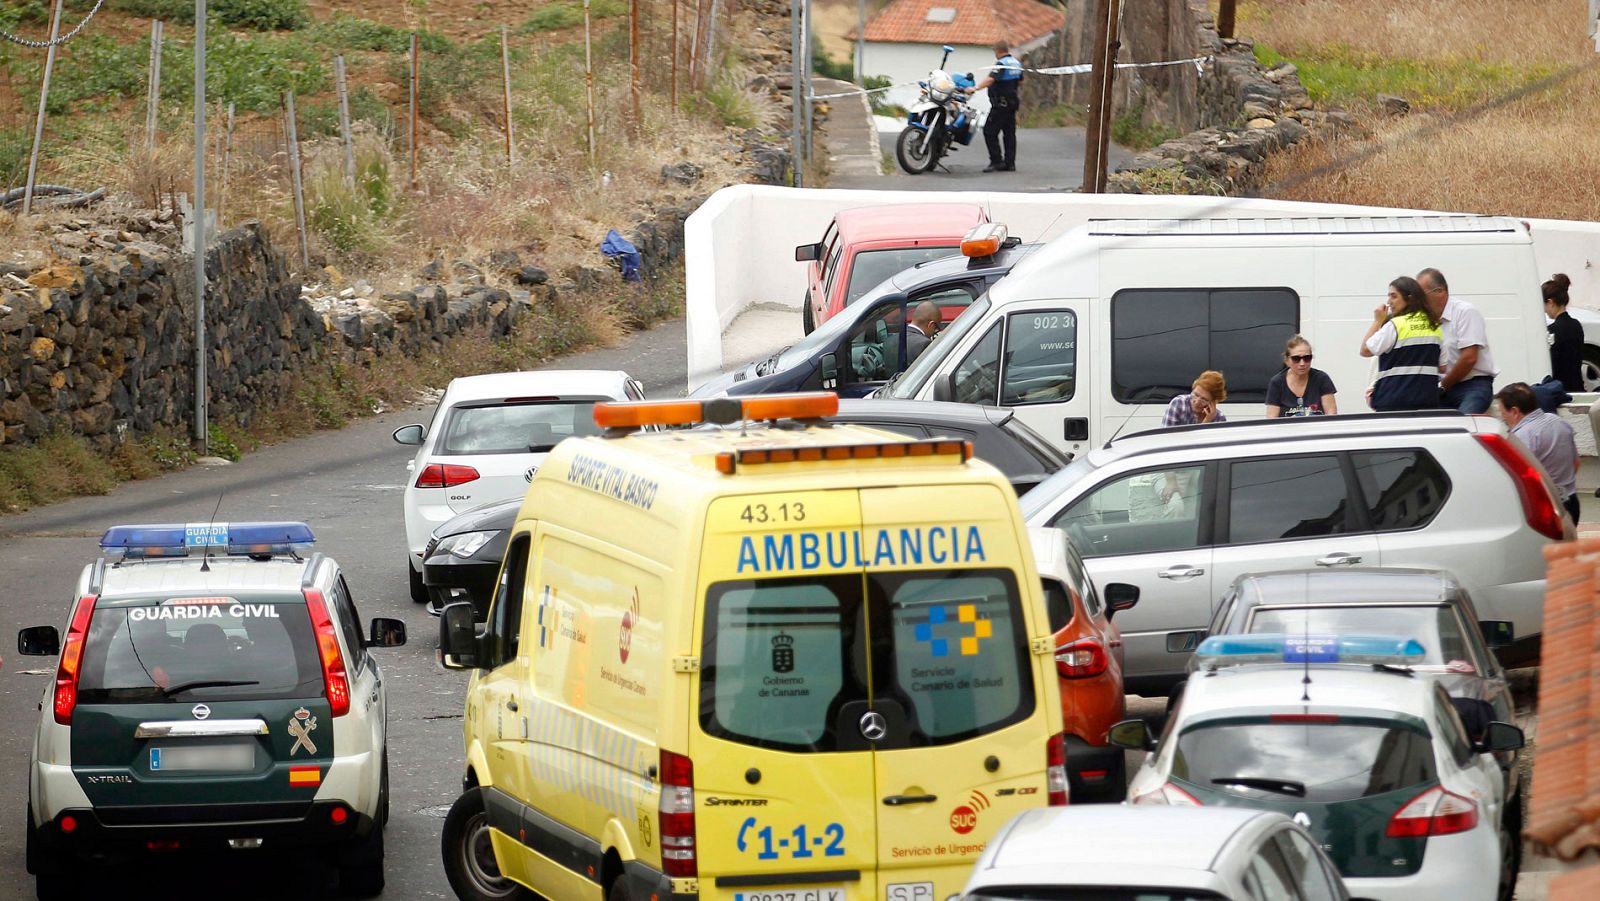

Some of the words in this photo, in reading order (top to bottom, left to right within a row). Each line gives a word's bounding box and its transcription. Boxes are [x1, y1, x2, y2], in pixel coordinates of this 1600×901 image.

[1033, 316, 1058, 329] 902
[567, 453, 607, 491] SOPORTE
[602, 464, 628, 500] VITAL
[624, 473, 659, 510] BASICO
[740, 502, 806, 523] 43.13
[186, 526, 228, 537] GUARDIA
[195, 536, 218, 545] CIVIL
[736, 525, 987, 574] AMBULANCIA
[130, 605, 223, 621] GUARDIA
[229, 603, 280, 618] CIVIL
[1285, 638, 1335, 646] GUARDIA
[1295, 645, 1326, 654] CIVIL
[911, 666, 956, 678] Servicio
[762, 676, 804, 686] Gobierno
[911, 681, 954, 692] Canario
[957, 679, 970, 689] de
[974, 677, 1004, 688] Salud
[758, 688, 770, 697] de
[772, 687, 810, 697] Canarias
[87, 775, 133, 784] X-TRAIL
[704, 796, 769, 807] SPRINTER
[951, 813, 977, 828] SUC
[757, 822, 846, 860] 1-1-2
[892, 846, 932, 858] Servicio
[935, 844, 947, 855] de
